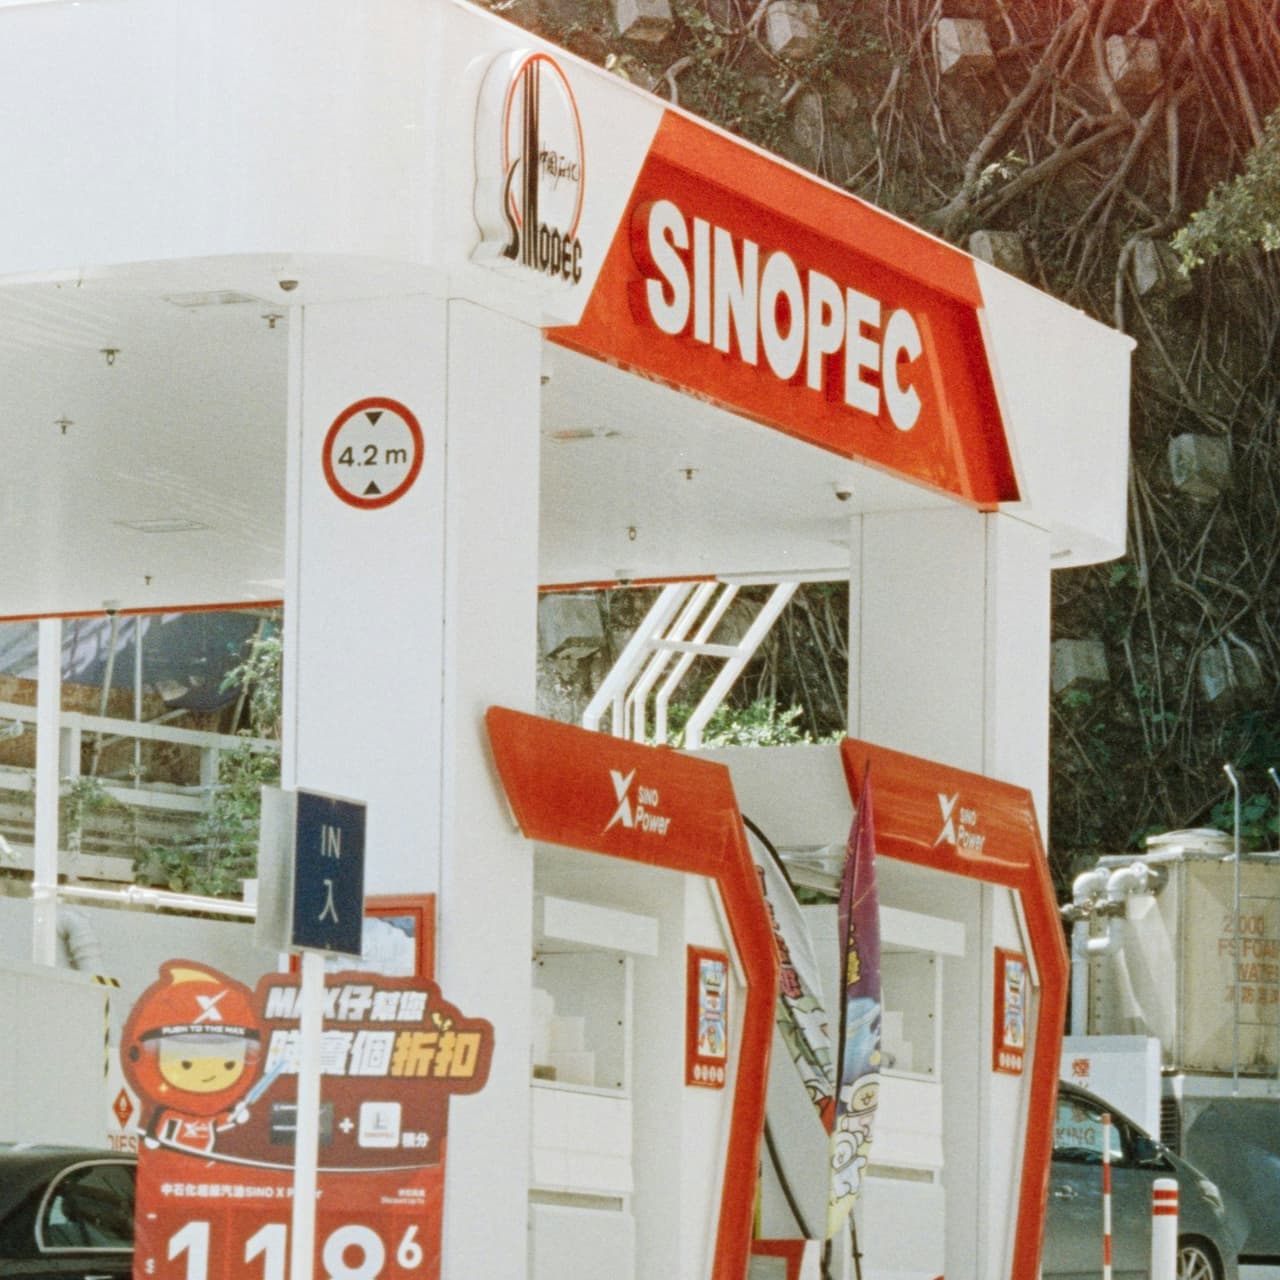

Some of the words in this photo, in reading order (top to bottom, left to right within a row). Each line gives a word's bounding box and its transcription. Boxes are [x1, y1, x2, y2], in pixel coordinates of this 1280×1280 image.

[646, 199, 923, 431] SINOPEC
[338, 444, 378, 467] 4.2
[385, 448, 407, 464] m
[639, 785, 659, 807] SINO
[634, 805, 672, 836] Power
[321, 824, 341, 859] IN
[318, 879, 339, 923] 入
[162, 1026, 188, 1035] PUSH
[190, 1025, 202, 1033] TO
[205, 1025, 223, 1033] THE
[225, 1026, 246, 1035] MAX
